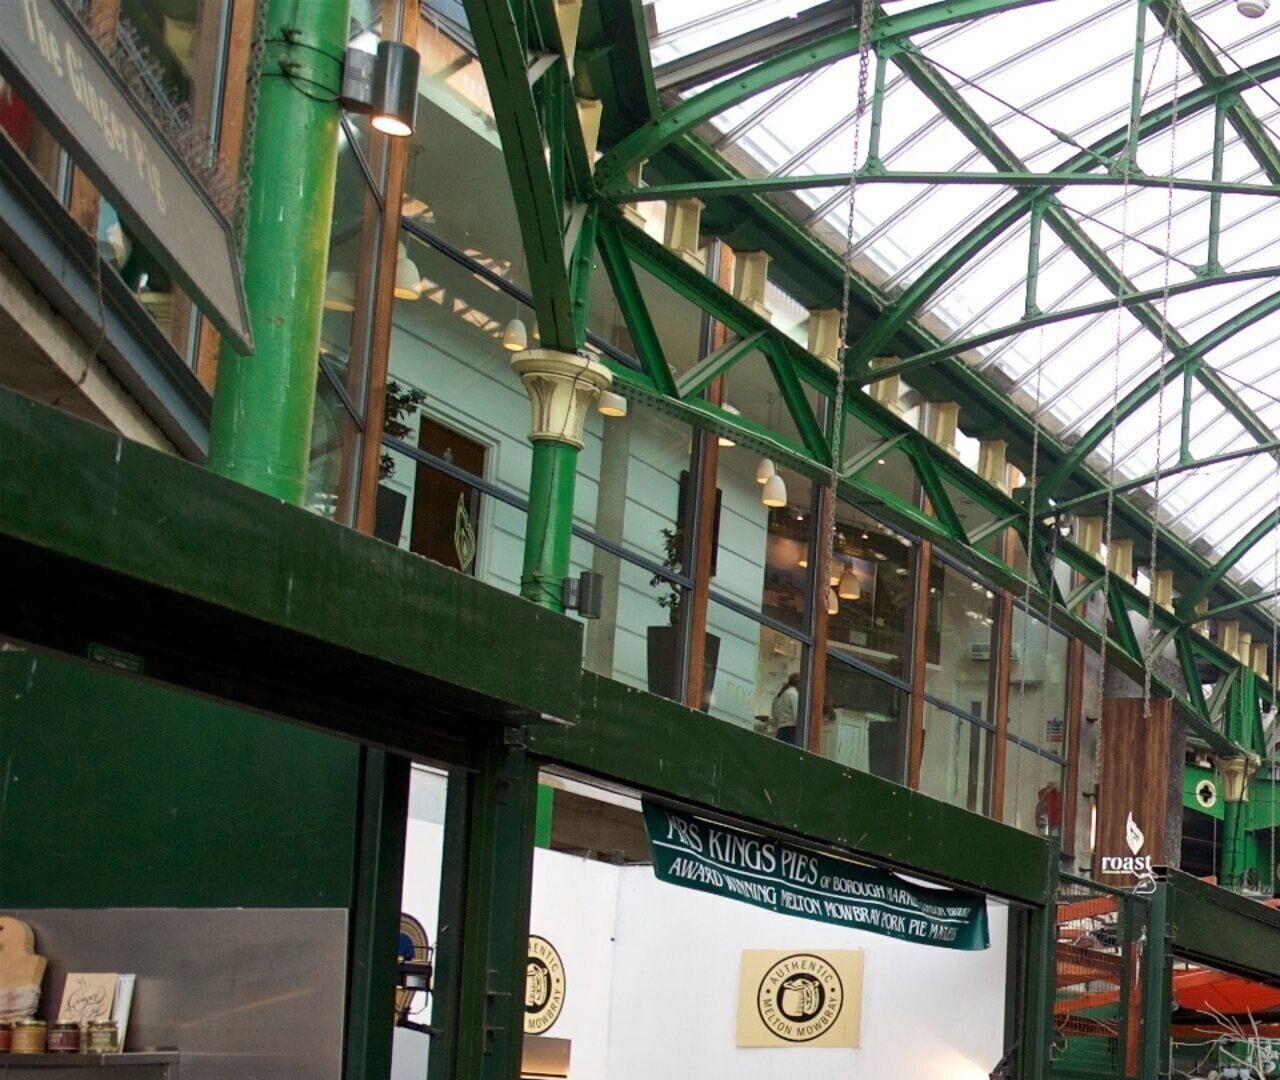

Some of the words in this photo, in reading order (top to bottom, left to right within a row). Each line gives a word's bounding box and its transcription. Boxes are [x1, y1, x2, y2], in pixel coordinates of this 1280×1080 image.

[781, 849, 818, 886] PIES
[833, 876, 886, 899] BOROUGH
[1101, 854, 1152, 872] roast
[669, 857, 724, 888] AWARD
[722, 873, 777, 905] WINNING
[780, 888, 823, 916] MELTON
[824, 901, 881, 926] MOWBRAY
[881, 911, 906, 934] PORK
[908, 918, 928, 938] PIE
[770, 960, 833, 985] AUTHENTIC
[763, 998, 793, 1035] MELTON
[796, 997, 838, 1036] MOWBRAY
